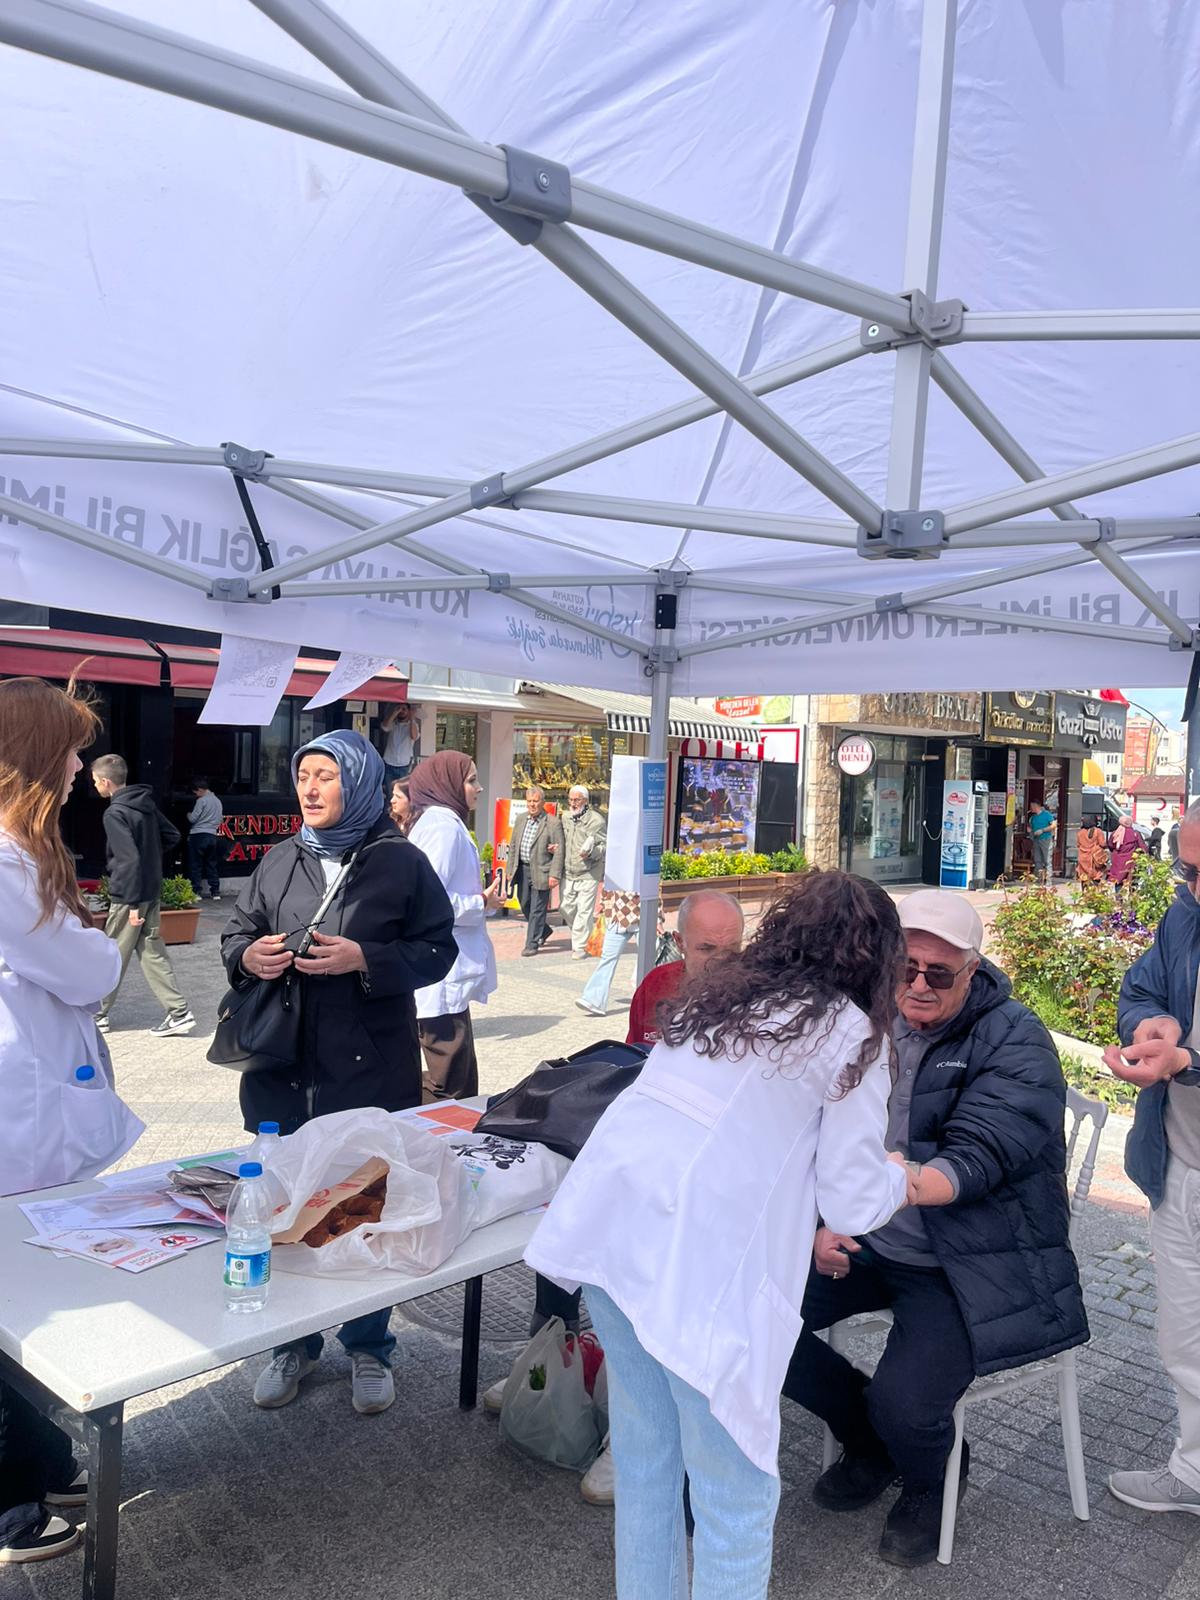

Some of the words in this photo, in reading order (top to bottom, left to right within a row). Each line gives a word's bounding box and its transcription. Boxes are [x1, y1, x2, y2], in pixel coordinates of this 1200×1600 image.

[1057, 711, 1084, 736] Gazi
[1100, 717, 1123, 740] Usta
[841, 744, 865, 753] OTEL
